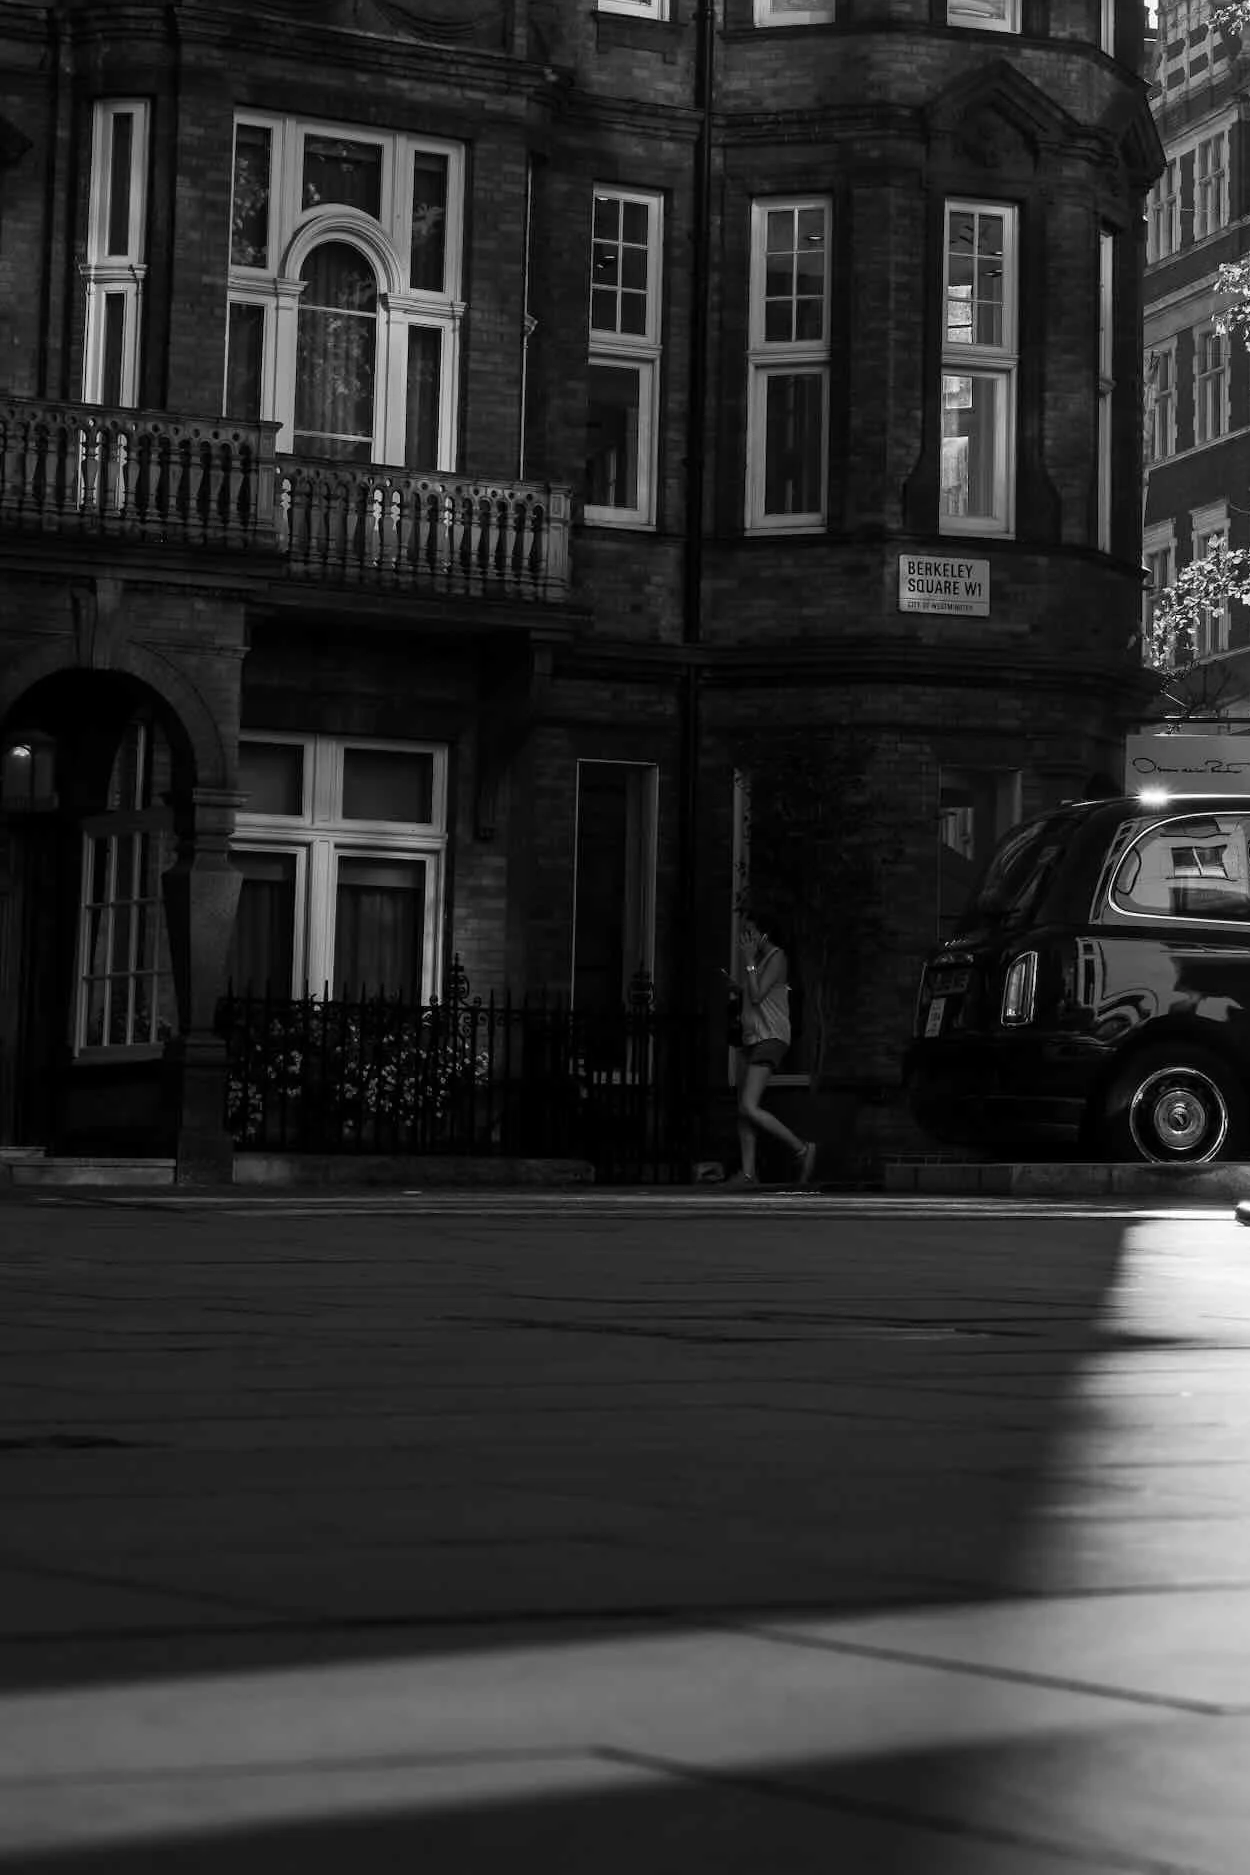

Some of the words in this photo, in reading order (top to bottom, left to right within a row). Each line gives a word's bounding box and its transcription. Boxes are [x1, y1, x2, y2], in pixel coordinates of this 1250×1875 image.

[907, 561, 973, 579] BERKELEY
[907, 578, 960, 595] SQUARE
[964, 581, 982, 597] W1
